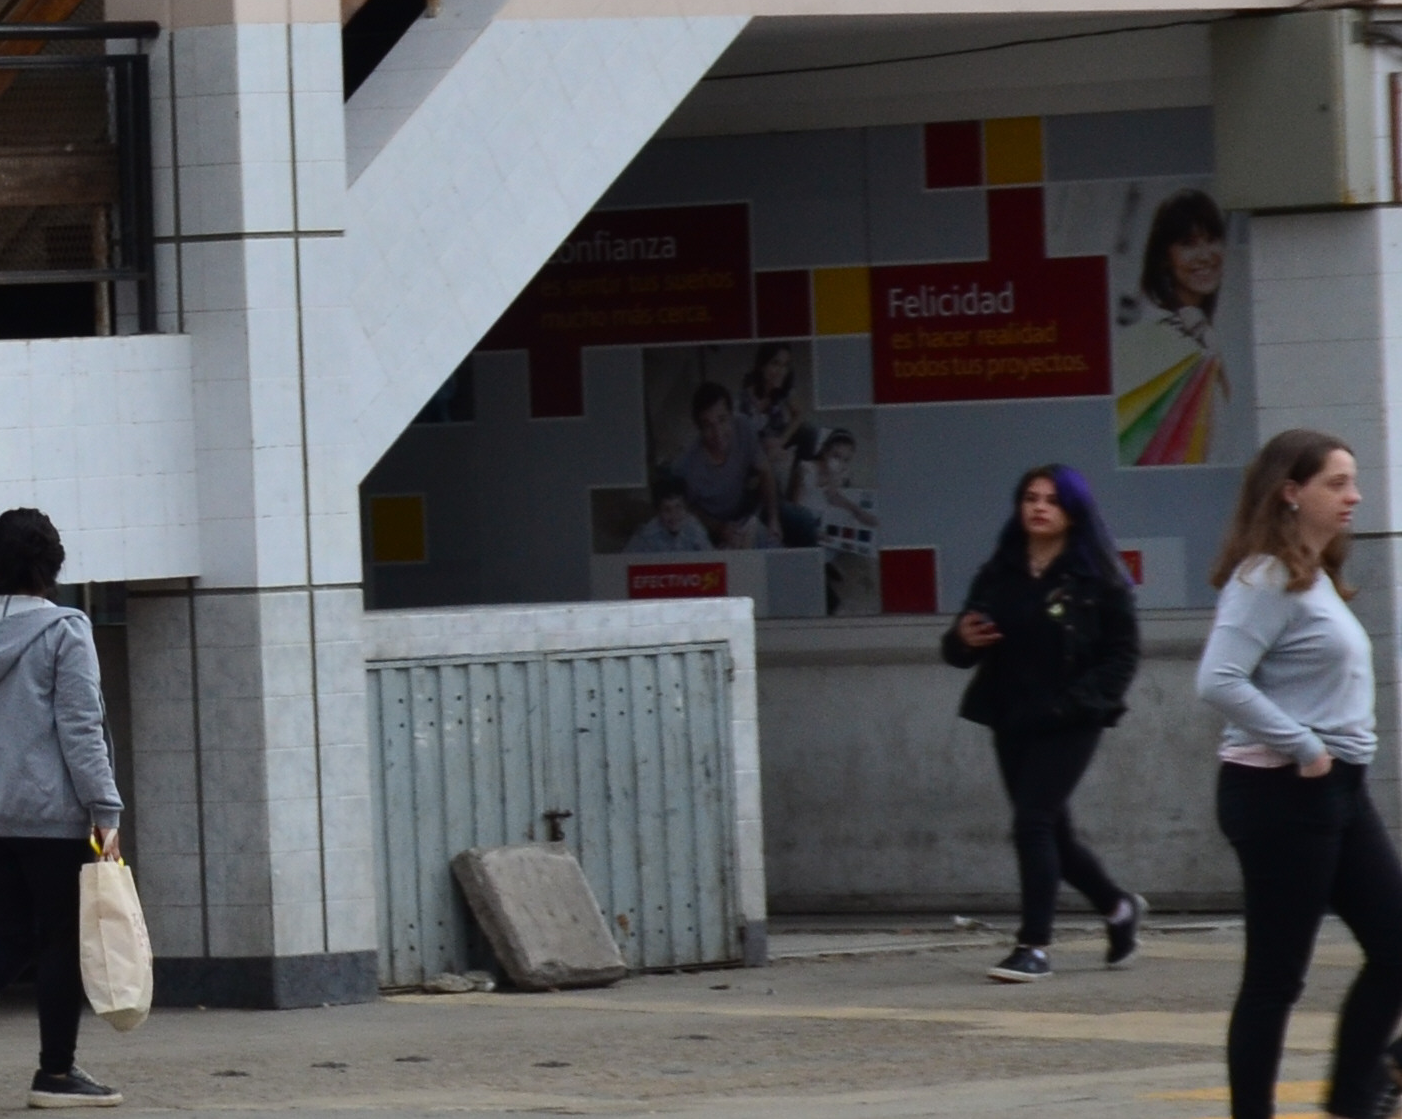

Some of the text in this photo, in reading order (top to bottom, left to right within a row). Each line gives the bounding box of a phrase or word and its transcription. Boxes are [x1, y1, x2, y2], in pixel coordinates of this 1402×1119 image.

[886, 280, 1016, 319] Felicidad
[891, 320, 1058, 350] es hacer realidad
[892, 353, 1090, 382] todos tus proyectos.
